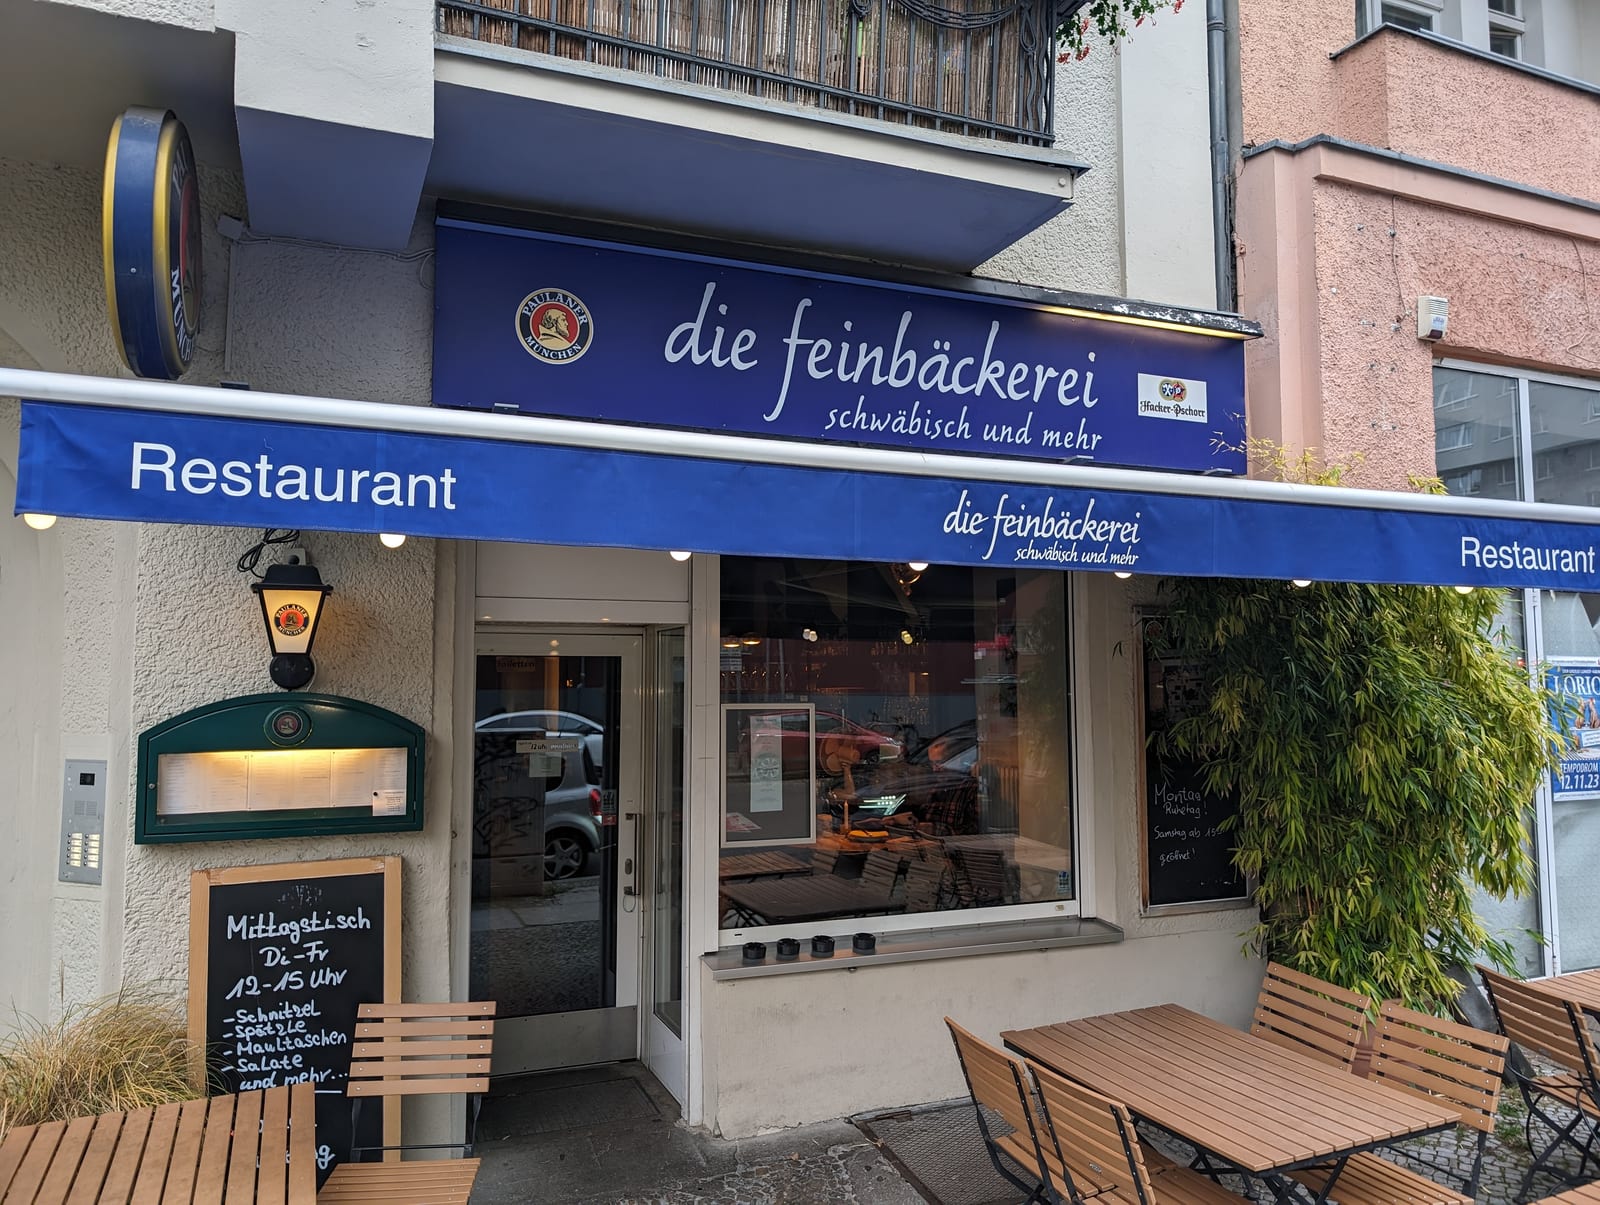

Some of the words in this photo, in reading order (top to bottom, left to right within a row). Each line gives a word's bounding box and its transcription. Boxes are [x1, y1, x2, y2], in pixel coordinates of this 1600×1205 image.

[522, 292, 588, 325] PAULANER
[664, 281, 758, 371] die
[763, 297, 1099, 423] feinbäckerei
[825, 395, 972, 441] schwäbisch
[982, 412, 1034, 445] und
[1042, 418, 1103, 452] mehr
[1139, 400, 1206, 418] Hacker-Pschorr
[131, 441, 457, 510] Restaurant
[943, 489, 989, 535] die
[981, 493, 1141, 560] feinbäckerei
[1014, 539, 1078, 564] schwäbisch
[1081, 543, 1109, 564] und
[1110, 545, 1140, 565] mehr
[1461, 536, 1596, 574] Restaurant
[1561, 773, 1600, 790] 12.11.23
[1188, 827, 1201, 838] ab
[227, 906, 371, 944] Mittagstisch
[309, 966, 348, 989] Uhr
[239, 1071, 277, 1090] und
